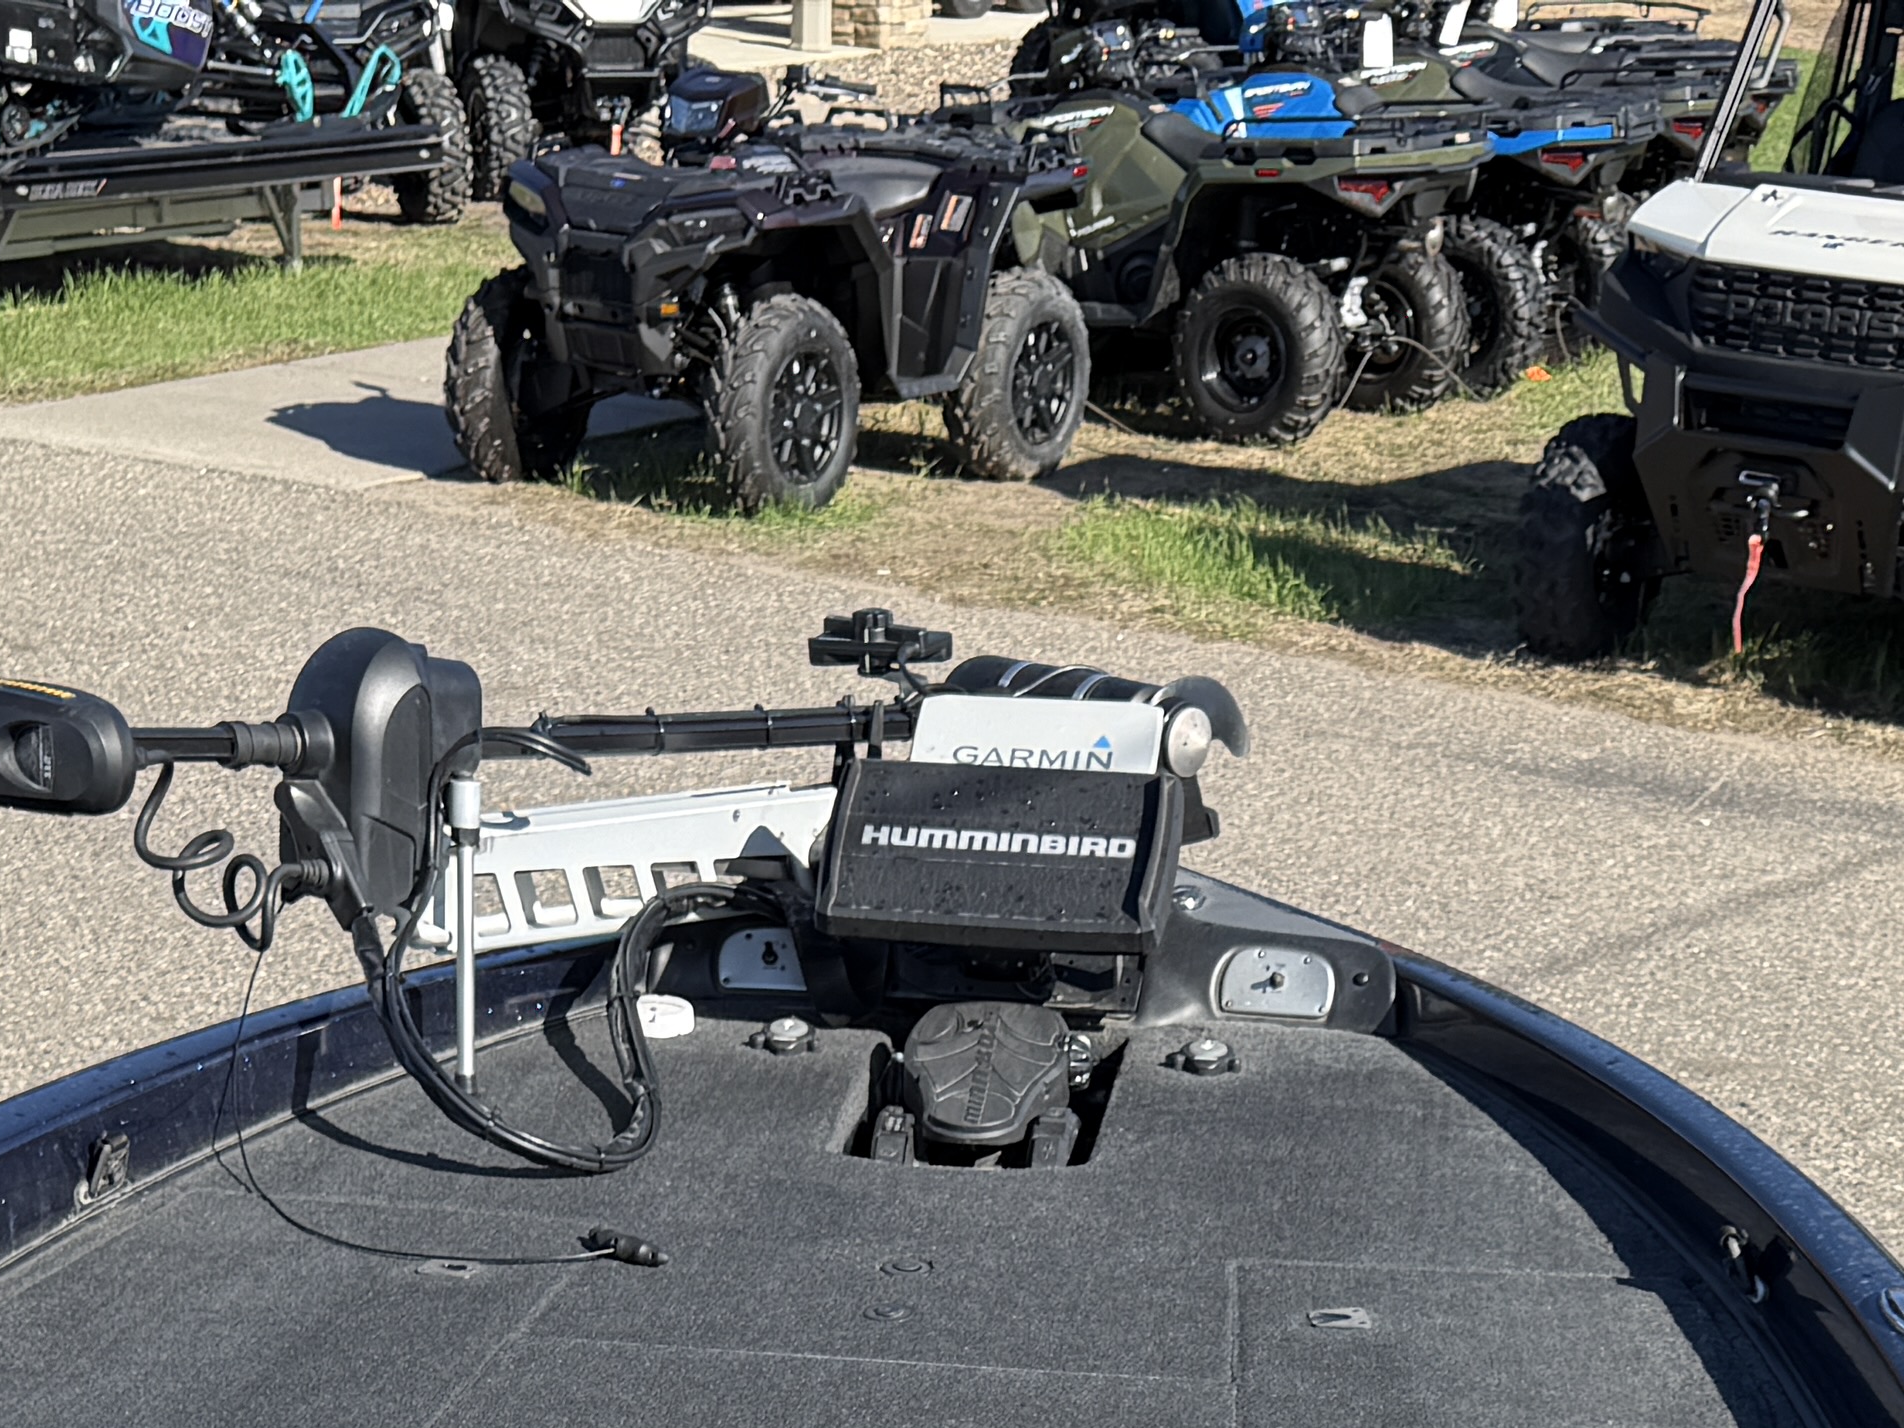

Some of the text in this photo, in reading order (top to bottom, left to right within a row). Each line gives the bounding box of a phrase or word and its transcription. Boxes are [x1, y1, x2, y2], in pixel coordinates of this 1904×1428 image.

[1727, 293, 1900, 340] POLARIS
[953, 745, 1114, 770] GARMIN
[861, 824, 1137, 859] HUMMINBIRD
